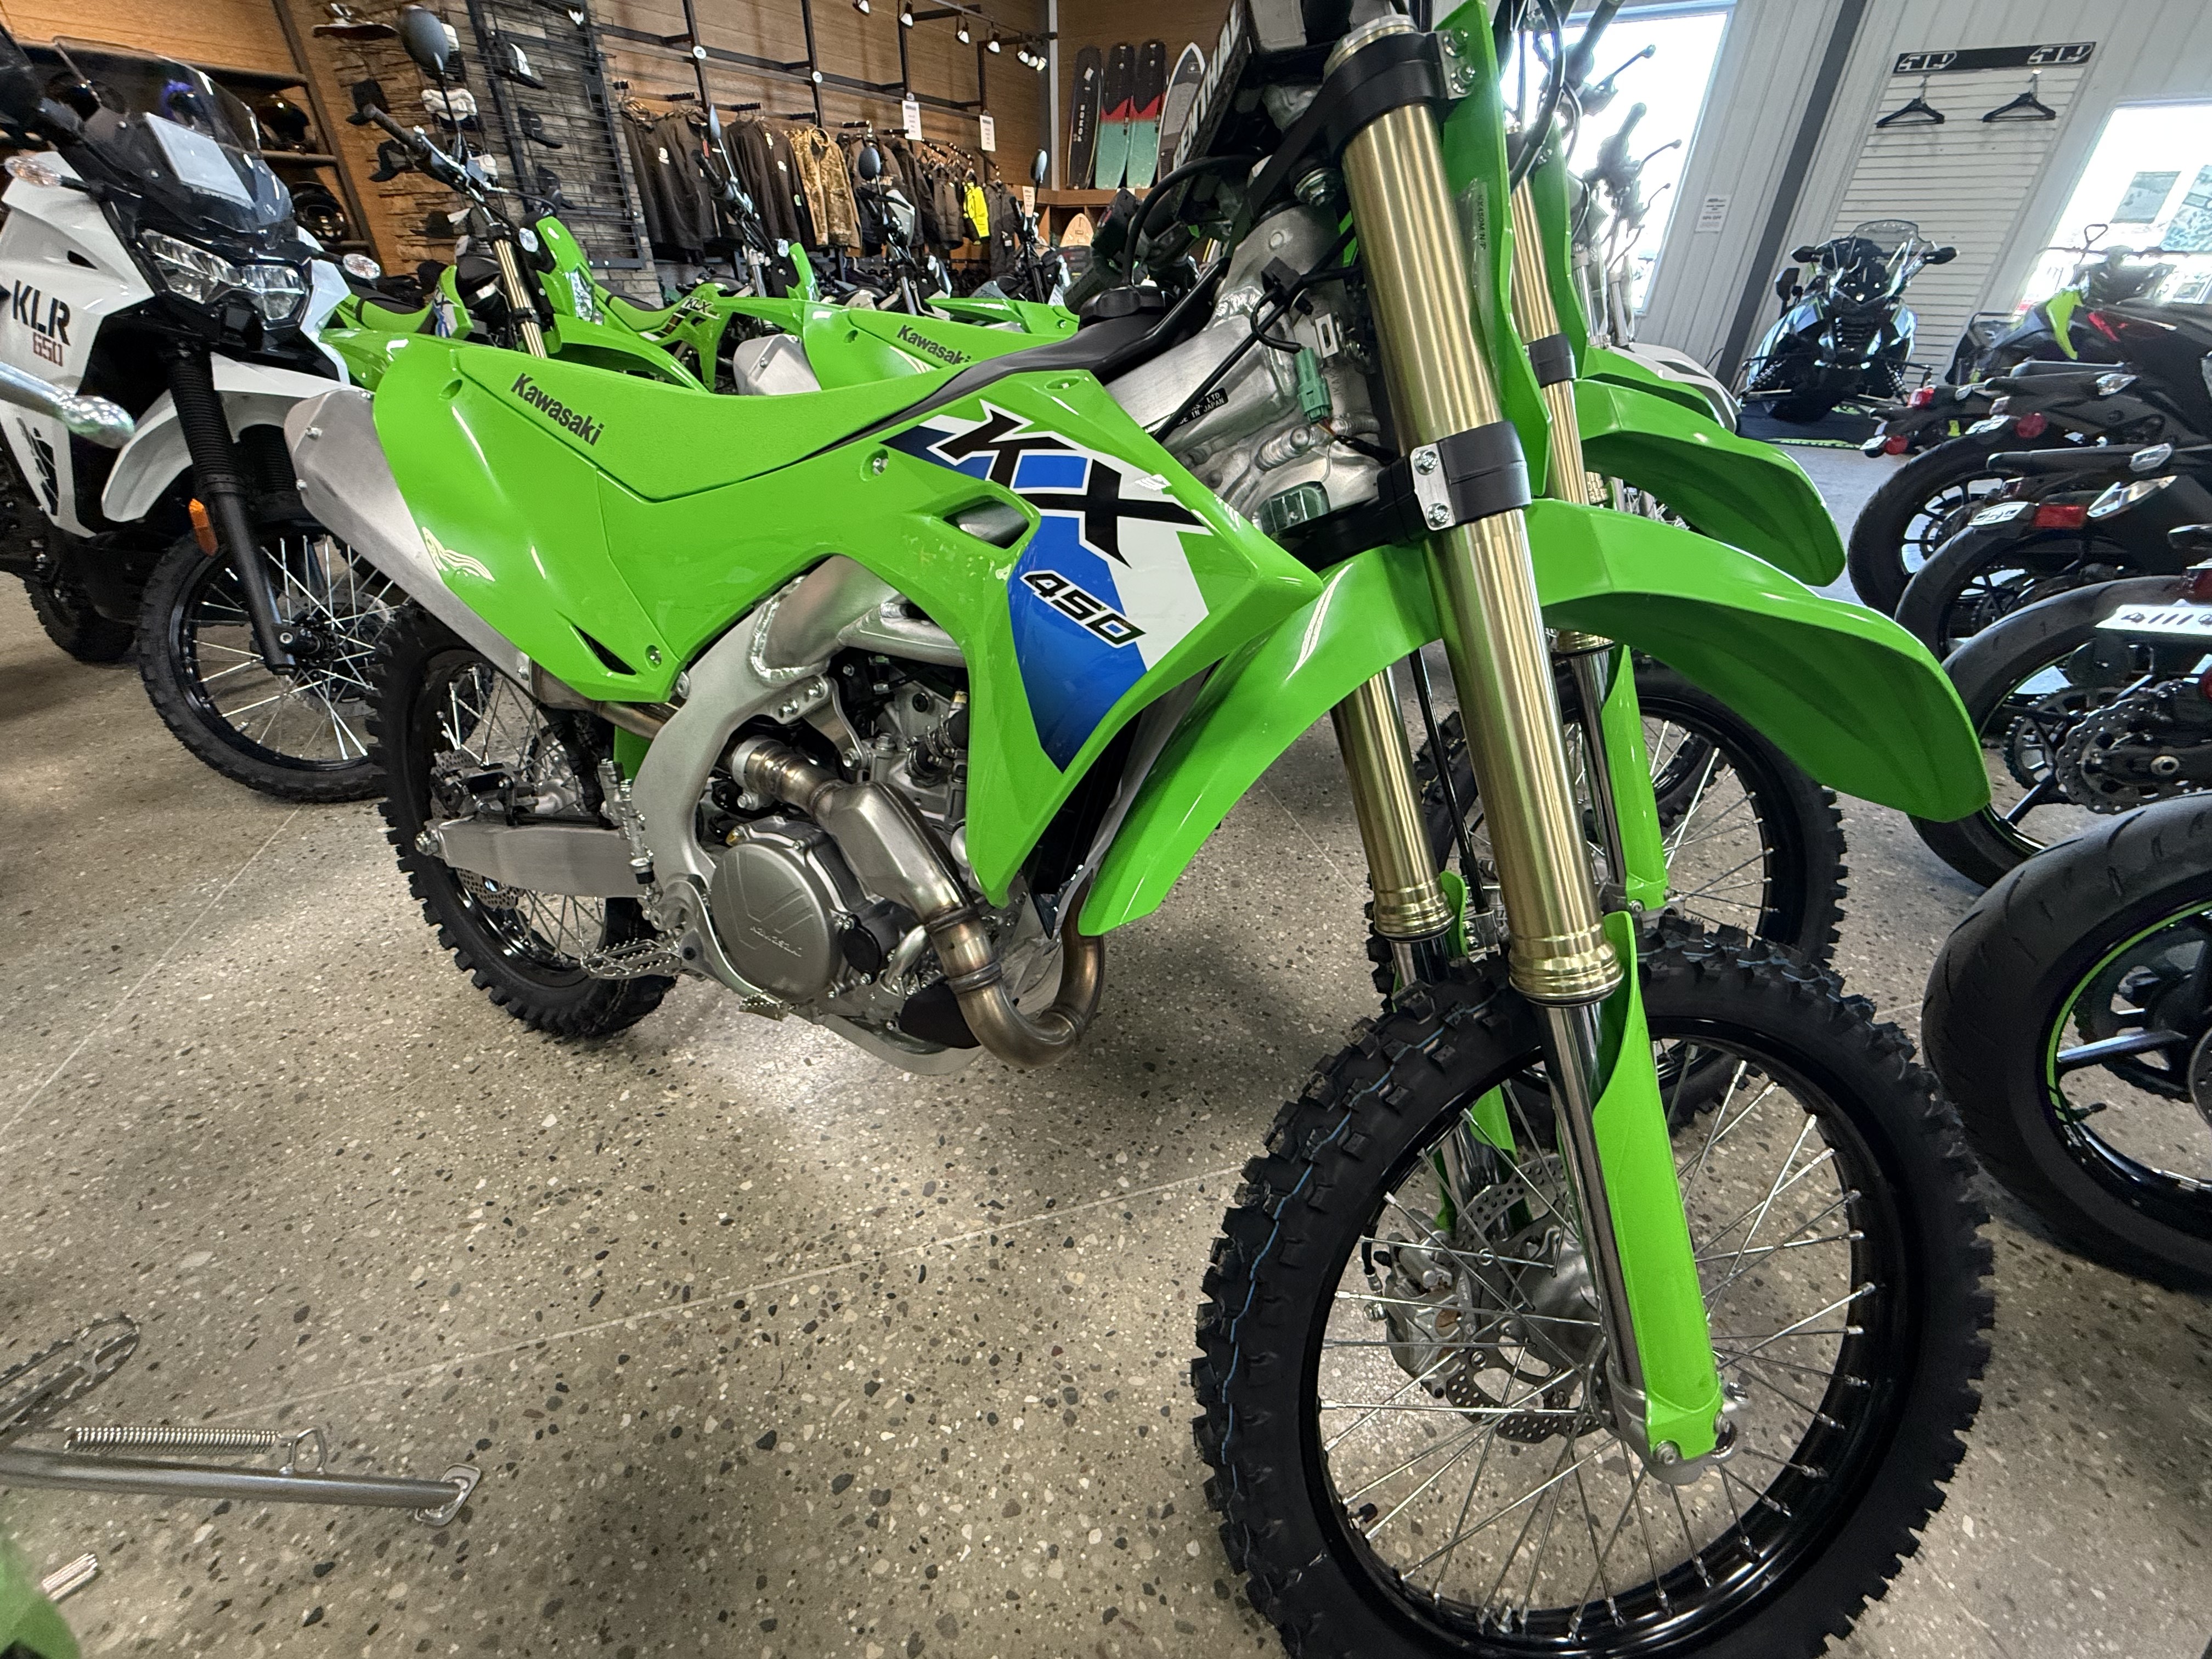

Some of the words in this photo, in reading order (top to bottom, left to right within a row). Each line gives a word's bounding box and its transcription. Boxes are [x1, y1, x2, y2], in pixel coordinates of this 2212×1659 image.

[13, 279, 71, 347] KLR
[33, 331, 64, 367] 650
[510, 373, 605, 446] Kawasaki
[1191, 409, 1201, 418] IN
[1203, 397, 1225, 413] JAPAN
[936, 408, 1207, 569] KX
[1022, 572, 1147, 646] 450
